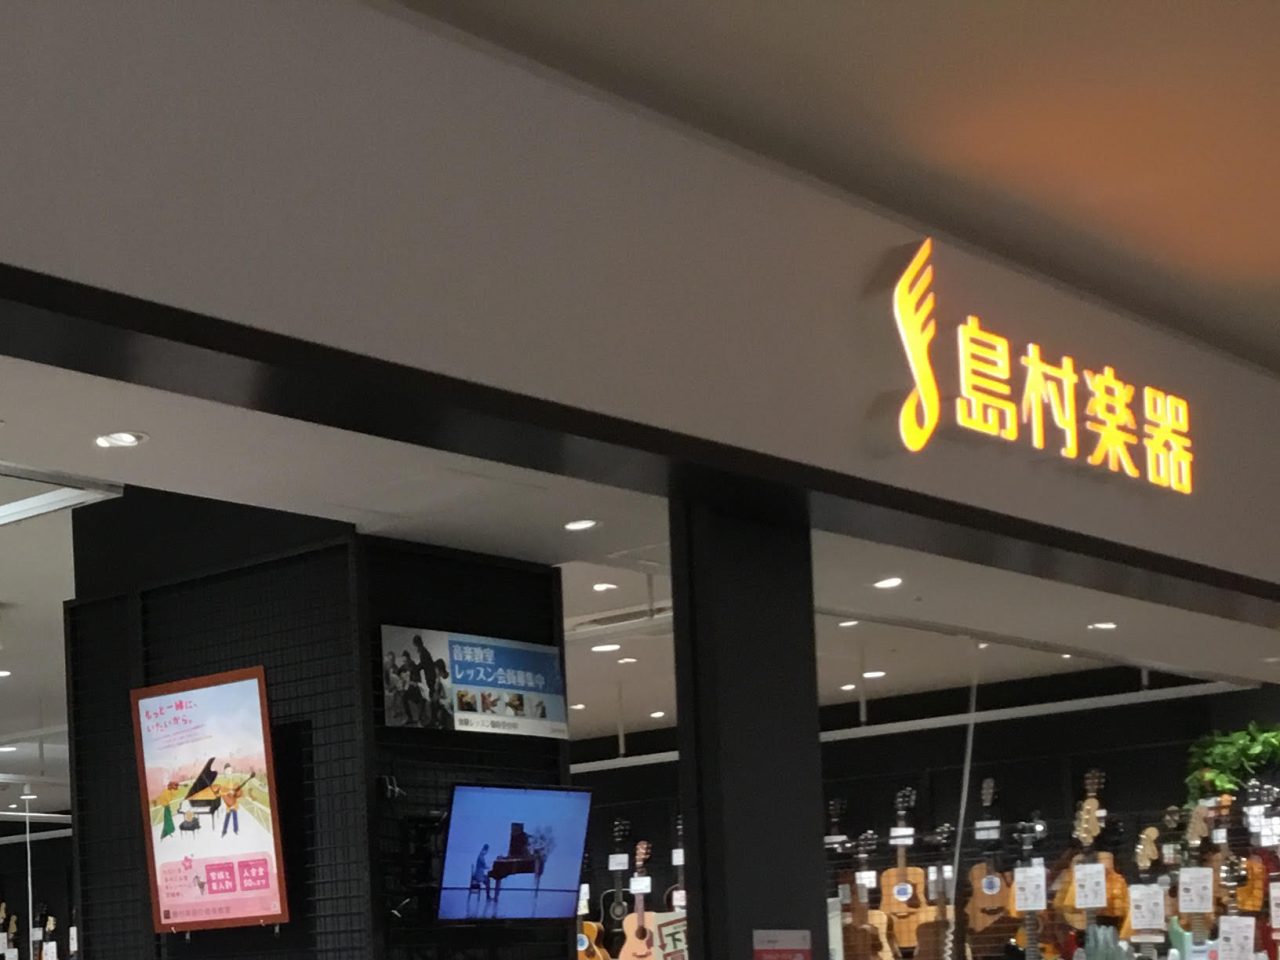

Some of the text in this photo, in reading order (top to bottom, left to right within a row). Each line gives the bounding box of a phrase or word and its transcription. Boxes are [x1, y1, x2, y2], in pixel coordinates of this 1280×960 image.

[956, 315, 1193, 494] 島村楽器
[453, 644, 495, 665] 音楽教室
[455, 664, 545, 689] レッスン会員募集中
